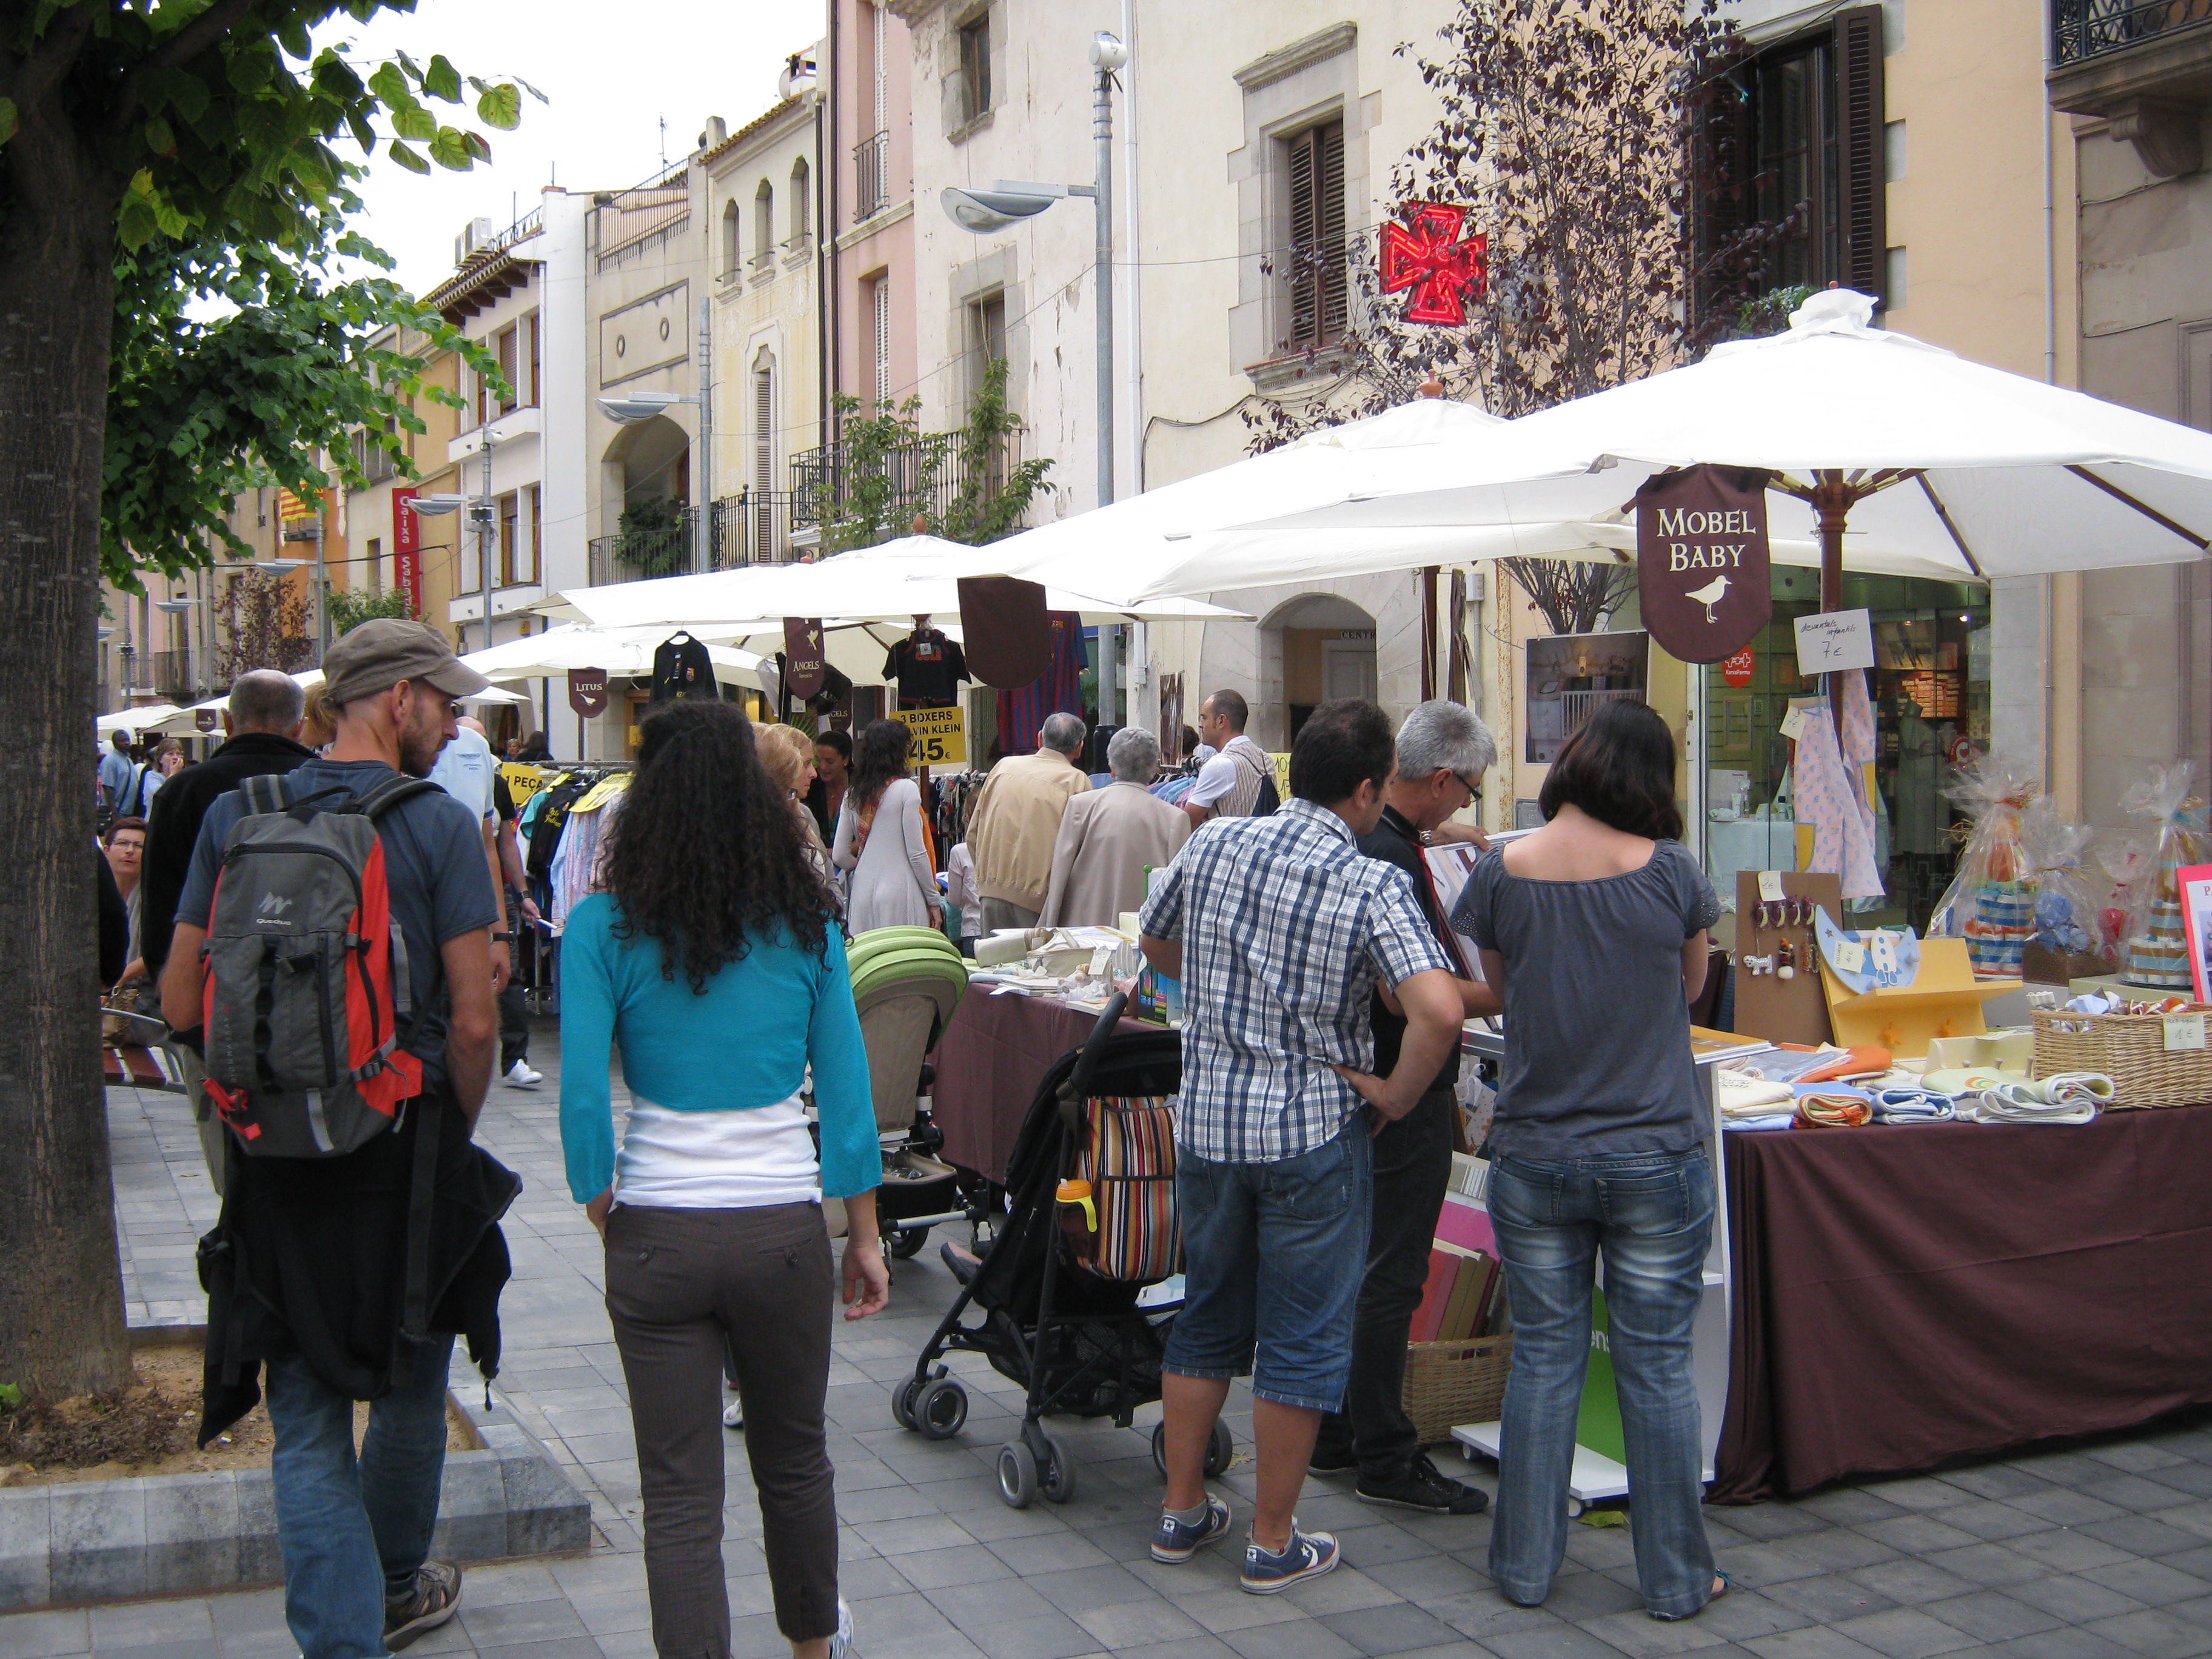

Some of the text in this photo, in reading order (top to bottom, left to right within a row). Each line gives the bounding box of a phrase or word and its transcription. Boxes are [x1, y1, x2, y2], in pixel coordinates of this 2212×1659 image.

[400, 495, 410, 544] Caixa
[1657, 508, 1757, 537] MOBEL
[1669, 543, 1746, 572] BABY
[793, 661, 820, 672] ANGELS
[575, 683, 603, 692] LITUS
[900, 711, 953, 723] 3 BOXERS
[911, 723, 961, 736] VIN KLEIN
[514, 776, 542, 792] PEÇA
[2203, 886, 2212, 896] P
